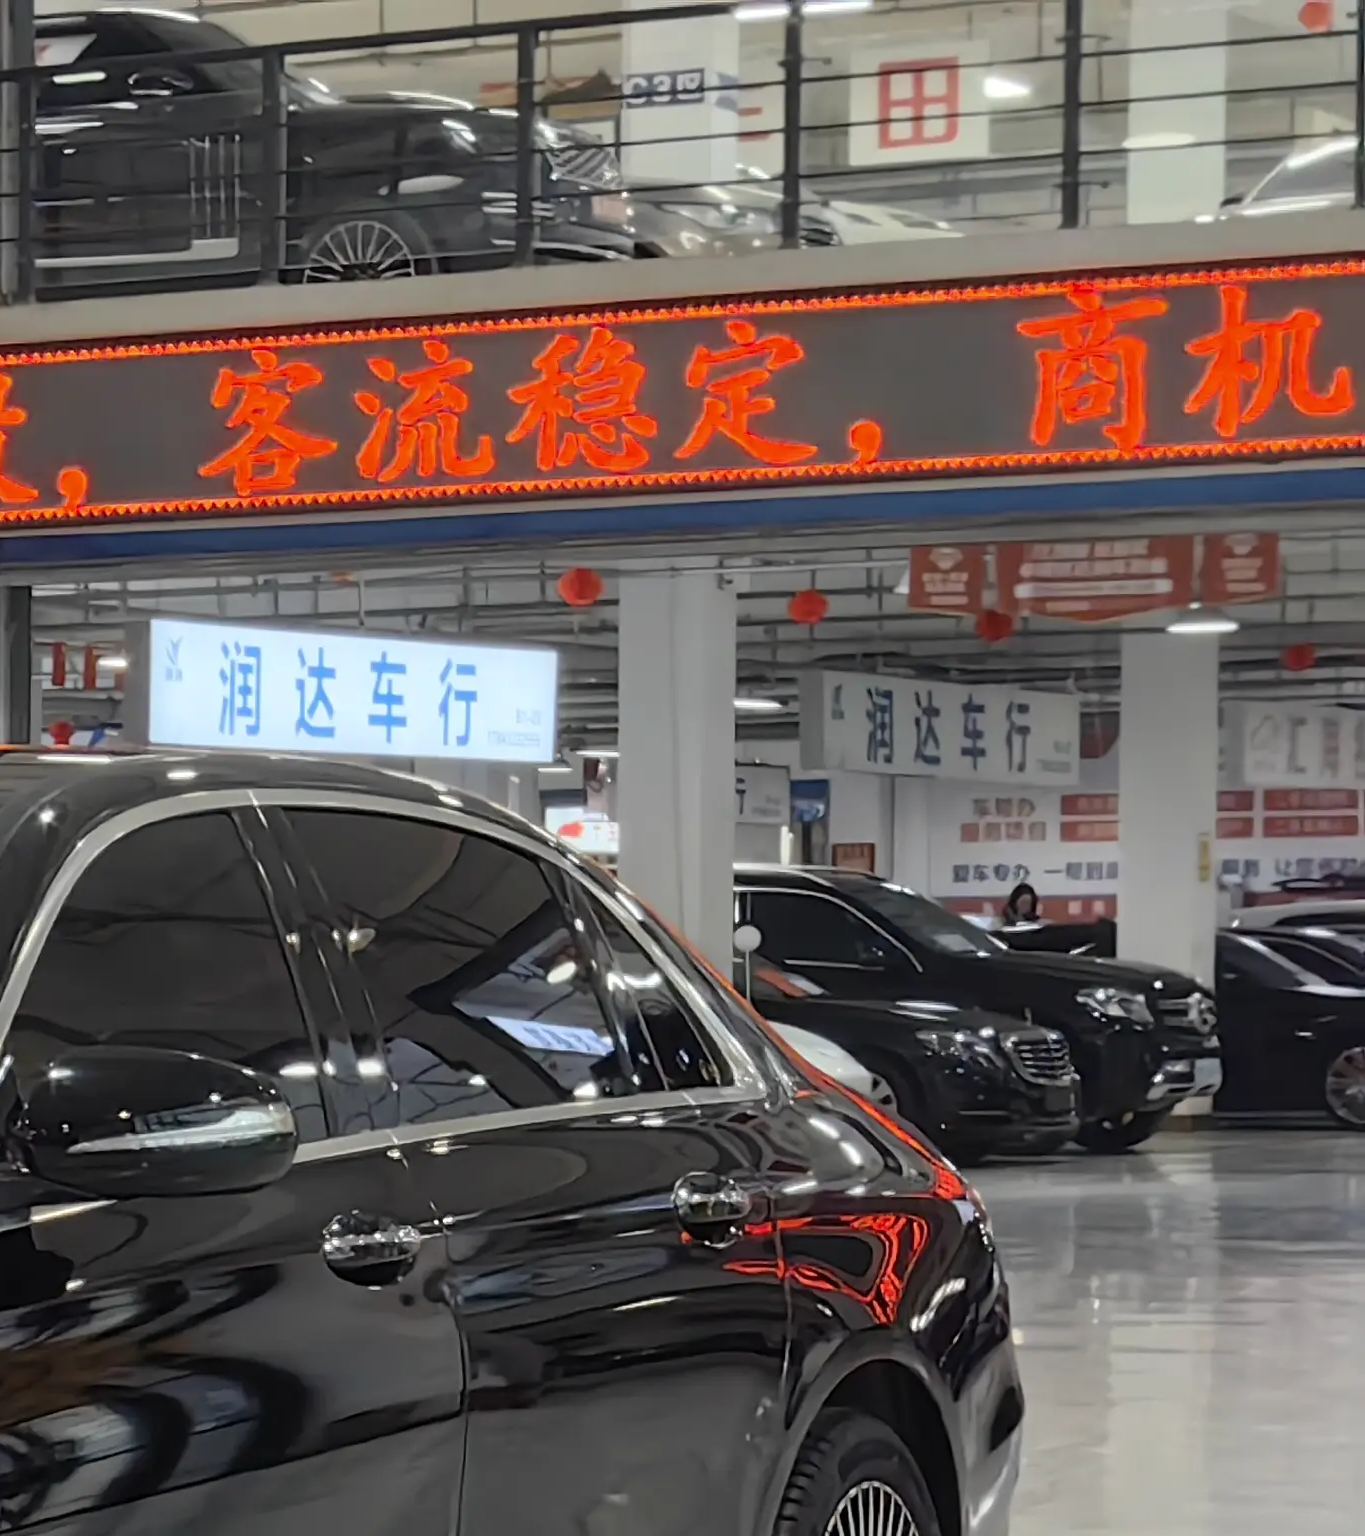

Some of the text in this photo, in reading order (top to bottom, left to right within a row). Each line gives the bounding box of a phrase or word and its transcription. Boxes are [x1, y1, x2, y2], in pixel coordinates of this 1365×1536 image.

[218, 641, 477, 747] 润达车行
[866, 686, 1031, 773] 润达车行
